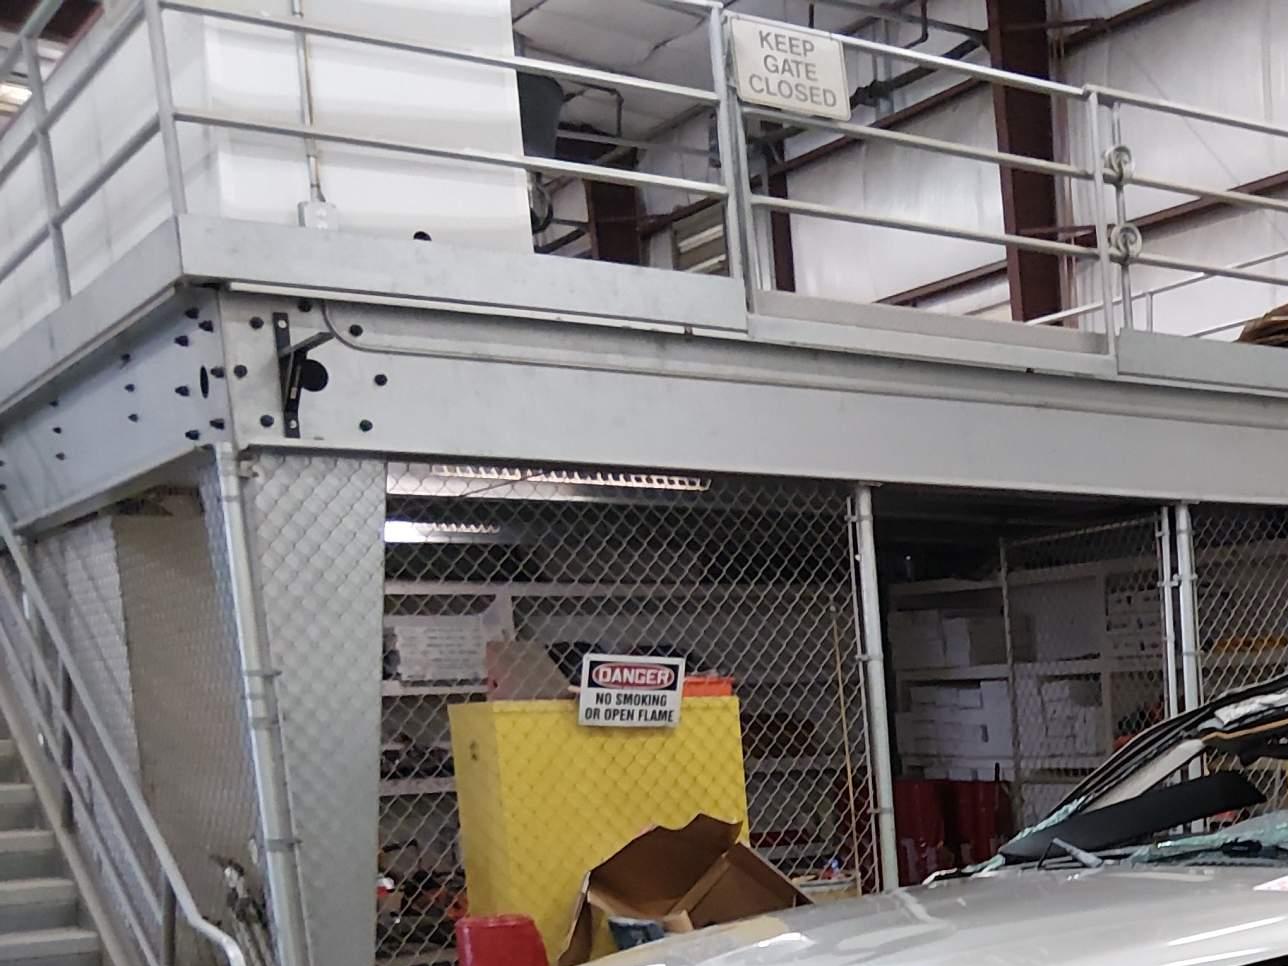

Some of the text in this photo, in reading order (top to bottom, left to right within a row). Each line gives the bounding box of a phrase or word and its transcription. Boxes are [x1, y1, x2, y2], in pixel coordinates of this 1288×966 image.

[759, 30, 815, 56] KEEP
[763, 54, 818, 81] GATE
[749, 74, 837, 107] CLOSED
[599, 667, 669, 685] DANGER
[595, 692, 667, 706] NO SMOKING
[584, 707, 674, 722] OR OPEN FLAME
